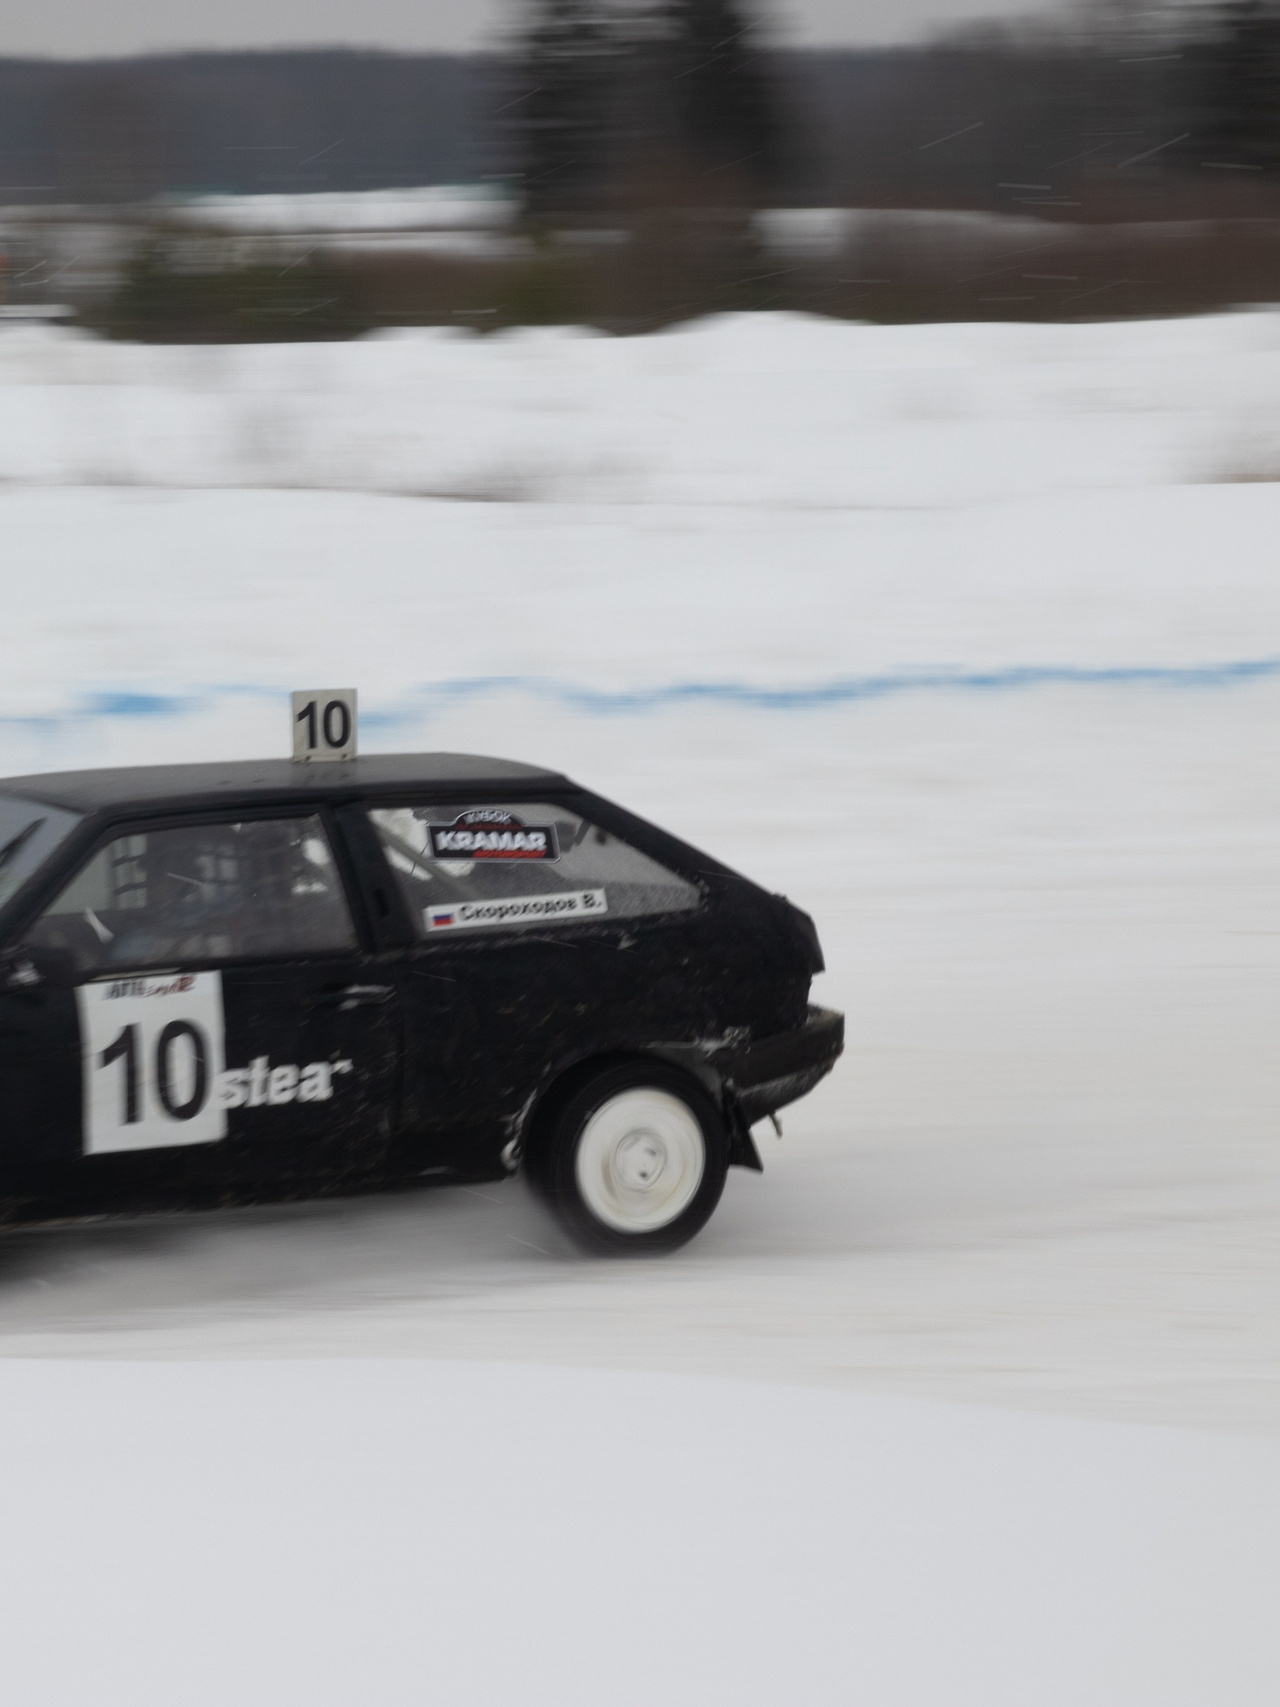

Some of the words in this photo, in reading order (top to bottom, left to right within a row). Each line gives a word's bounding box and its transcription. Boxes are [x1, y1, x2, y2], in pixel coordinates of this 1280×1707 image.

[294, 700, 351, 749] 10
[435, 830, 547, 851] KRAMAR
[460, 898, 577, 921] Скороходов
[582, 892, 602, 911] В.
[97, 1019, 211, 1126] 10
